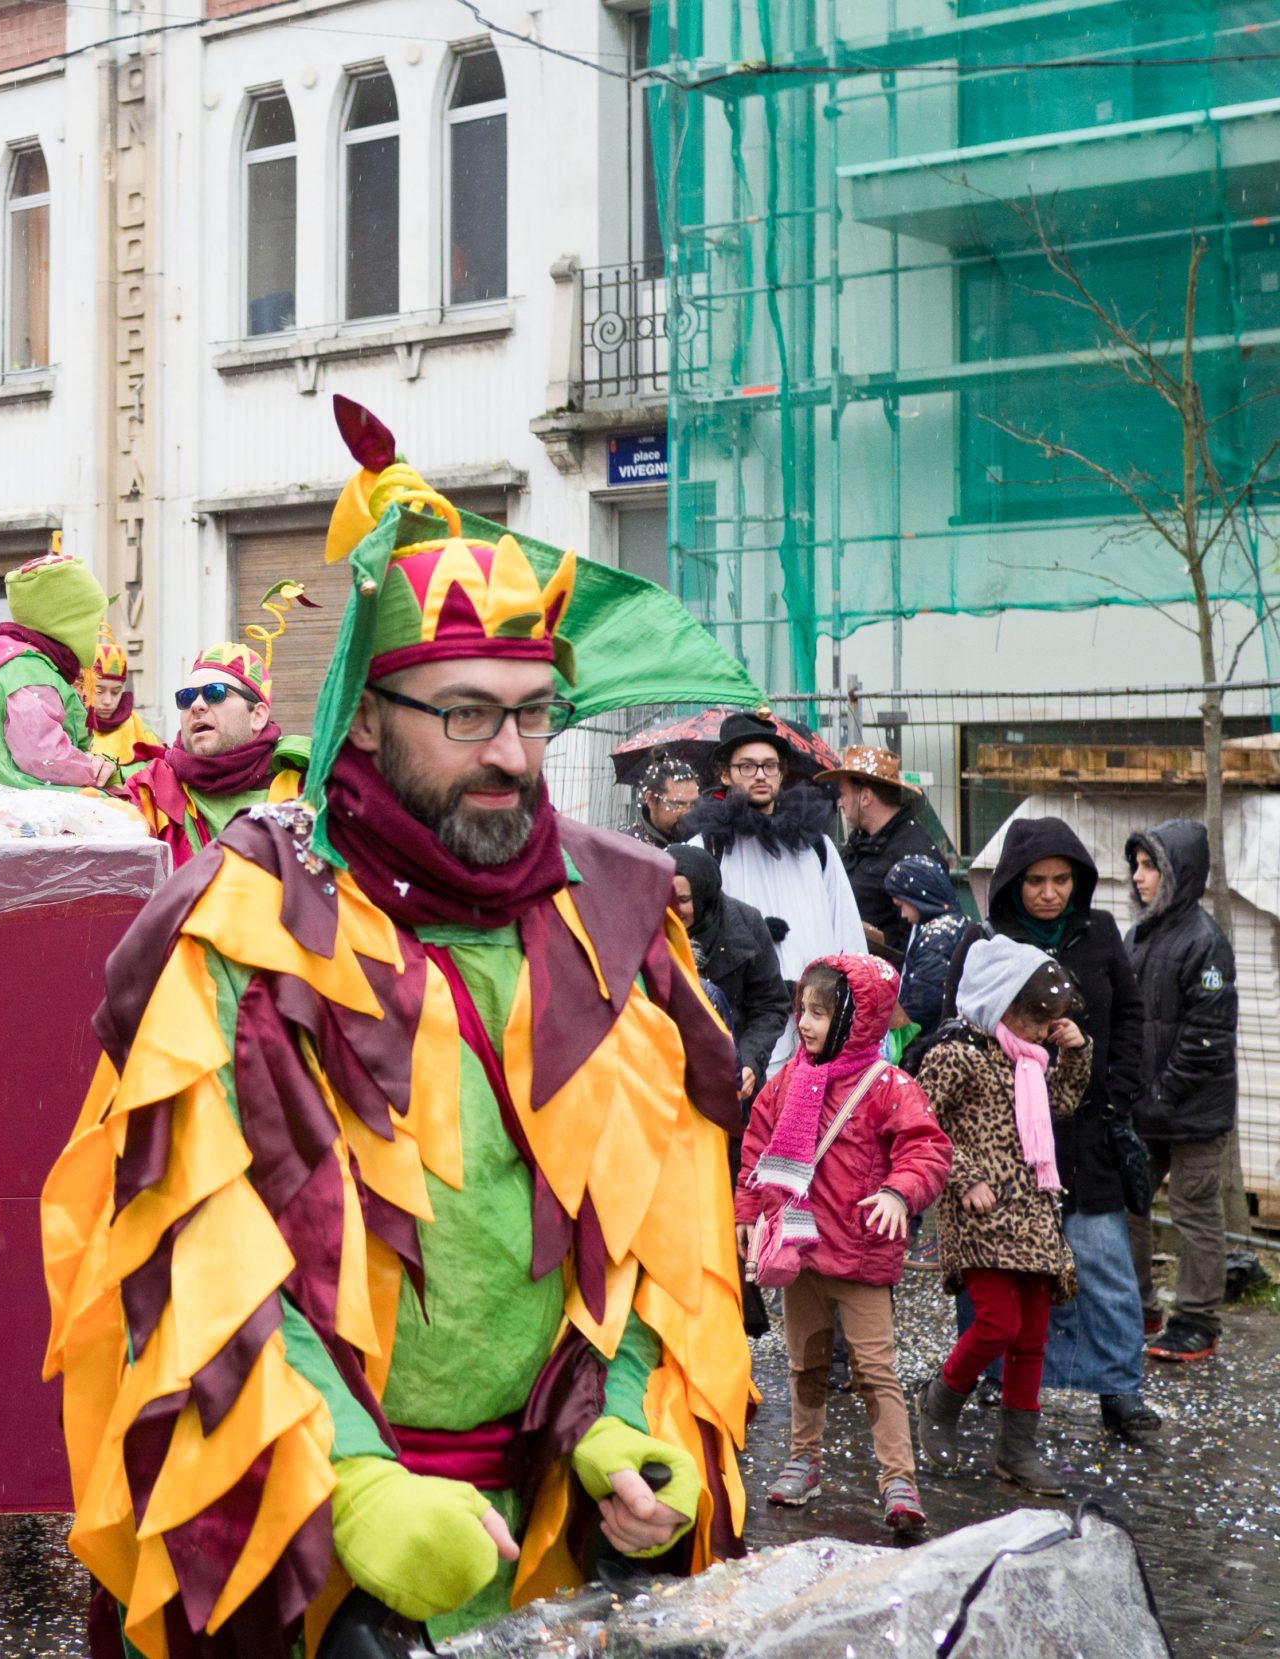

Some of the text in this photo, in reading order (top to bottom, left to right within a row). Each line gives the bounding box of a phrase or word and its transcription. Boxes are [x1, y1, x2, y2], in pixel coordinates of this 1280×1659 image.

[633, 450, 661, 464] place
[618, 463, 669, 478] VIVEGNI
[1203, 971, 1220, 988] 78
